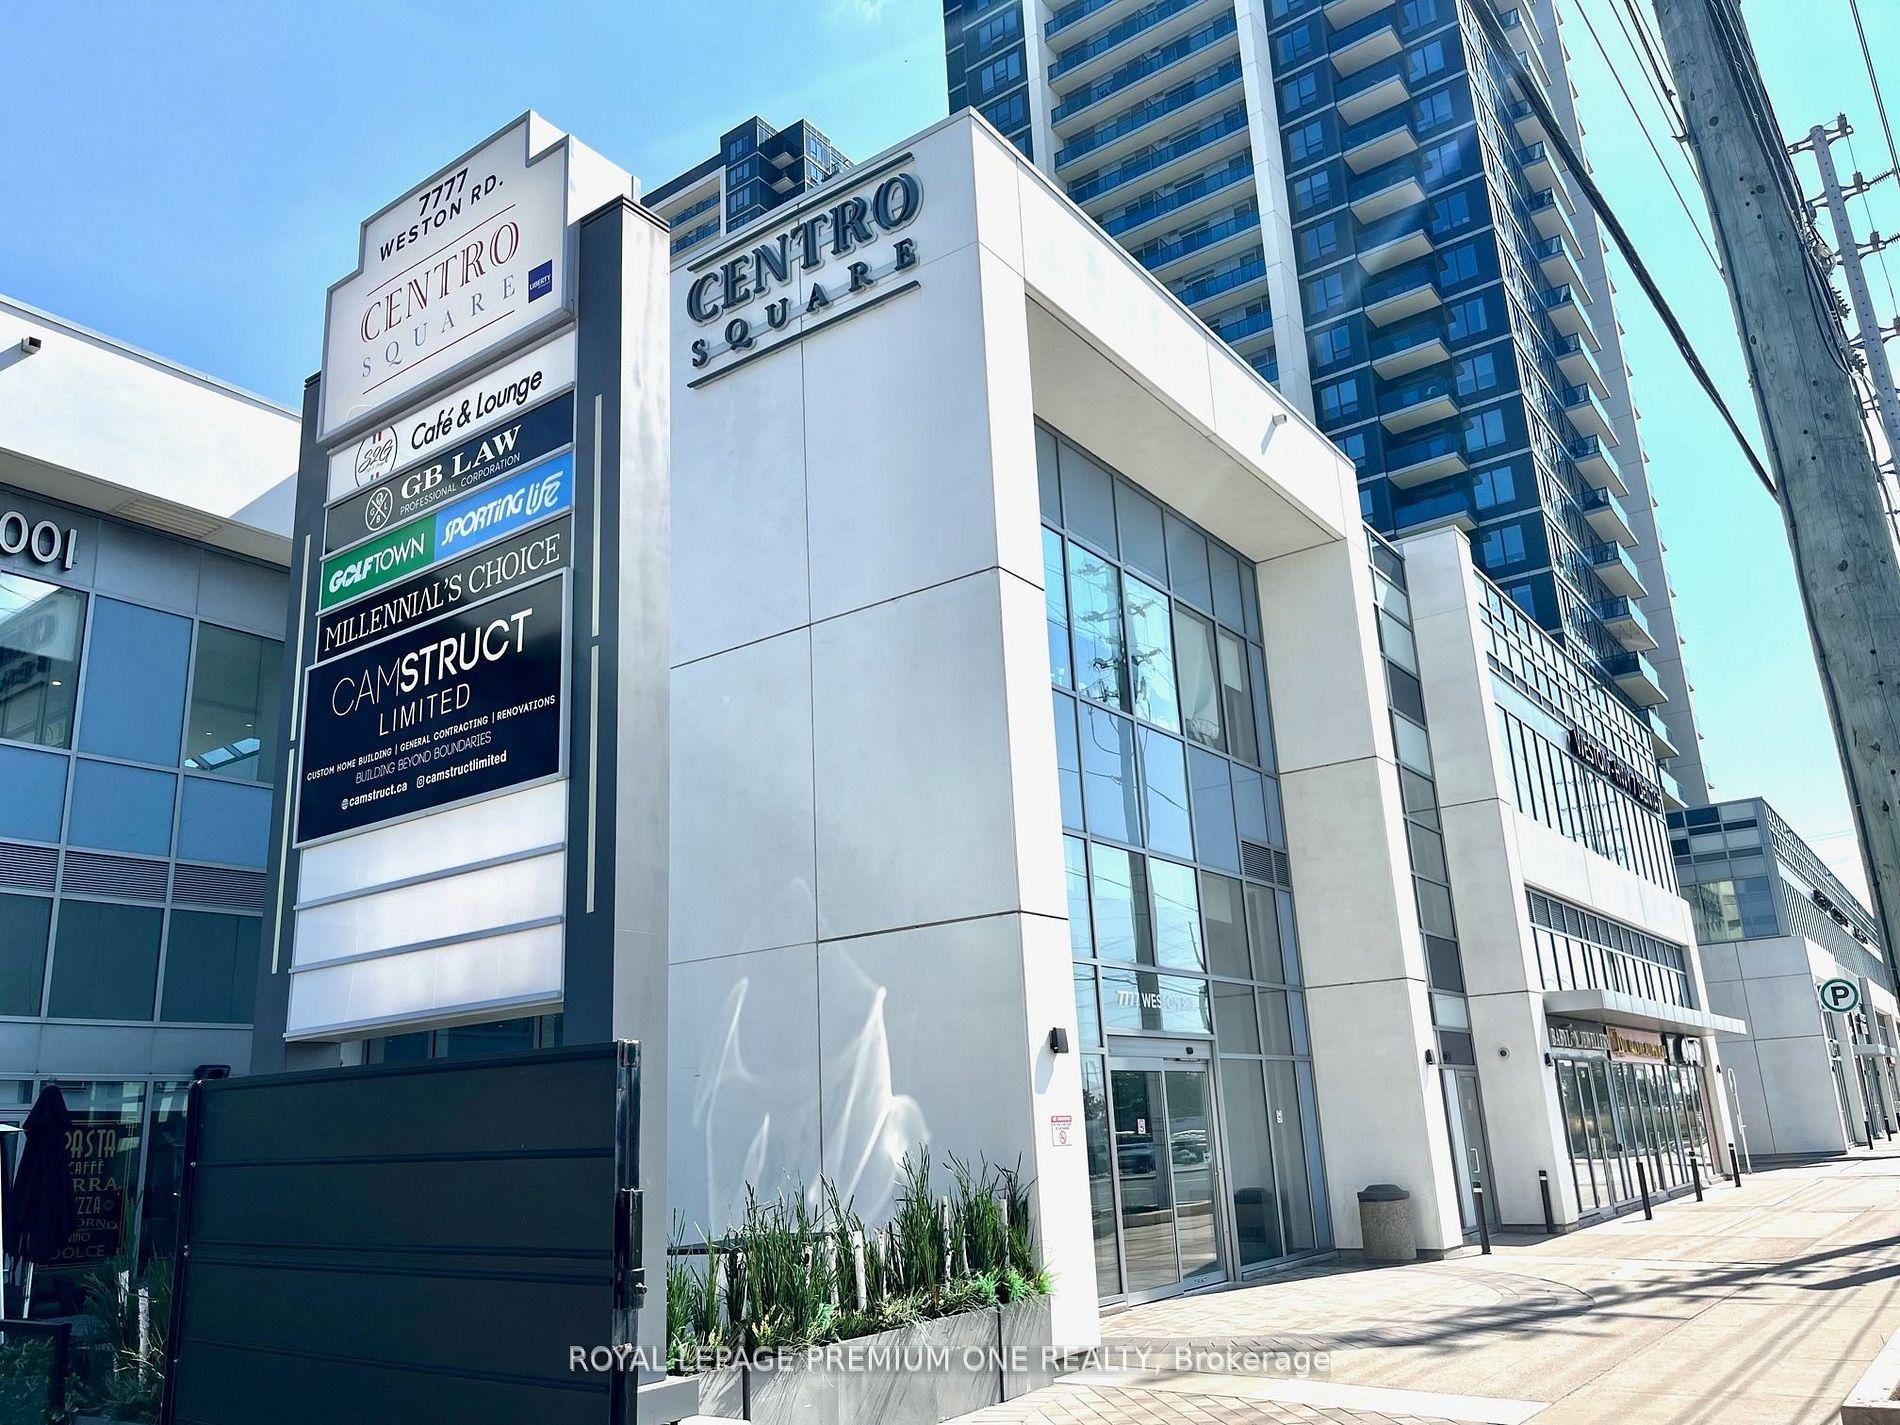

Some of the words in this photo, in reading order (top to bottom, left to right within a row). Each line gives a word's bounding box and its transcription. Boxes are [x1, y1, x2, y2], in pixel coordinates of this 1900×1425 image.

[380, 198, 463, 262] WESTON
[470, 174, 503, 205] RD.
[419, 168, 468, 216] 7777
[360, 221, 520, 343] CENTRO
[530, 274, 551, 290] LIBERTY
[687, 173, 921, 323] CENTRO
[362, 274, 516, 378] SQUARE
[691, 238, 918, 368] SQUARE
[411, 407, 453, 450] Café
[457, 401, 471, 429] &
[476, 370, 543, 418] Lounge
[400, 483, 457, 515] PROFESSIONAL
[460, 452, 521, 487] CORPORATION
[401, 460, 443, 499] GB
[452, 425, 522, 477] LAW
[324, 574, 463, 651] MILLENNIAL'S
[468, 534, 561, 594] CHOICE
[332, 608, 533, 716] CAMSTRUCT
[307, 765, 335, 781] CUSTOM
[336, 758, 356, 773] HOME
[358, 747, 392, 766] BUILDING
[400, 735, 431, 752] GENERAL
[433, 715, 489, 741] CONTRACTING
[497, 695, 556, 721] RENOVATIONS
[379, 683, 471, 736] LIMITED
[349, 782, 408, 807] camstruct.ca
[425, 750, 507, 784] camstructlimited
[355, 761, 396, 784] BUILDING
[397, 750, 432, 771] BEYOND
[433, 730, 492, 760] BOUNDARIES
